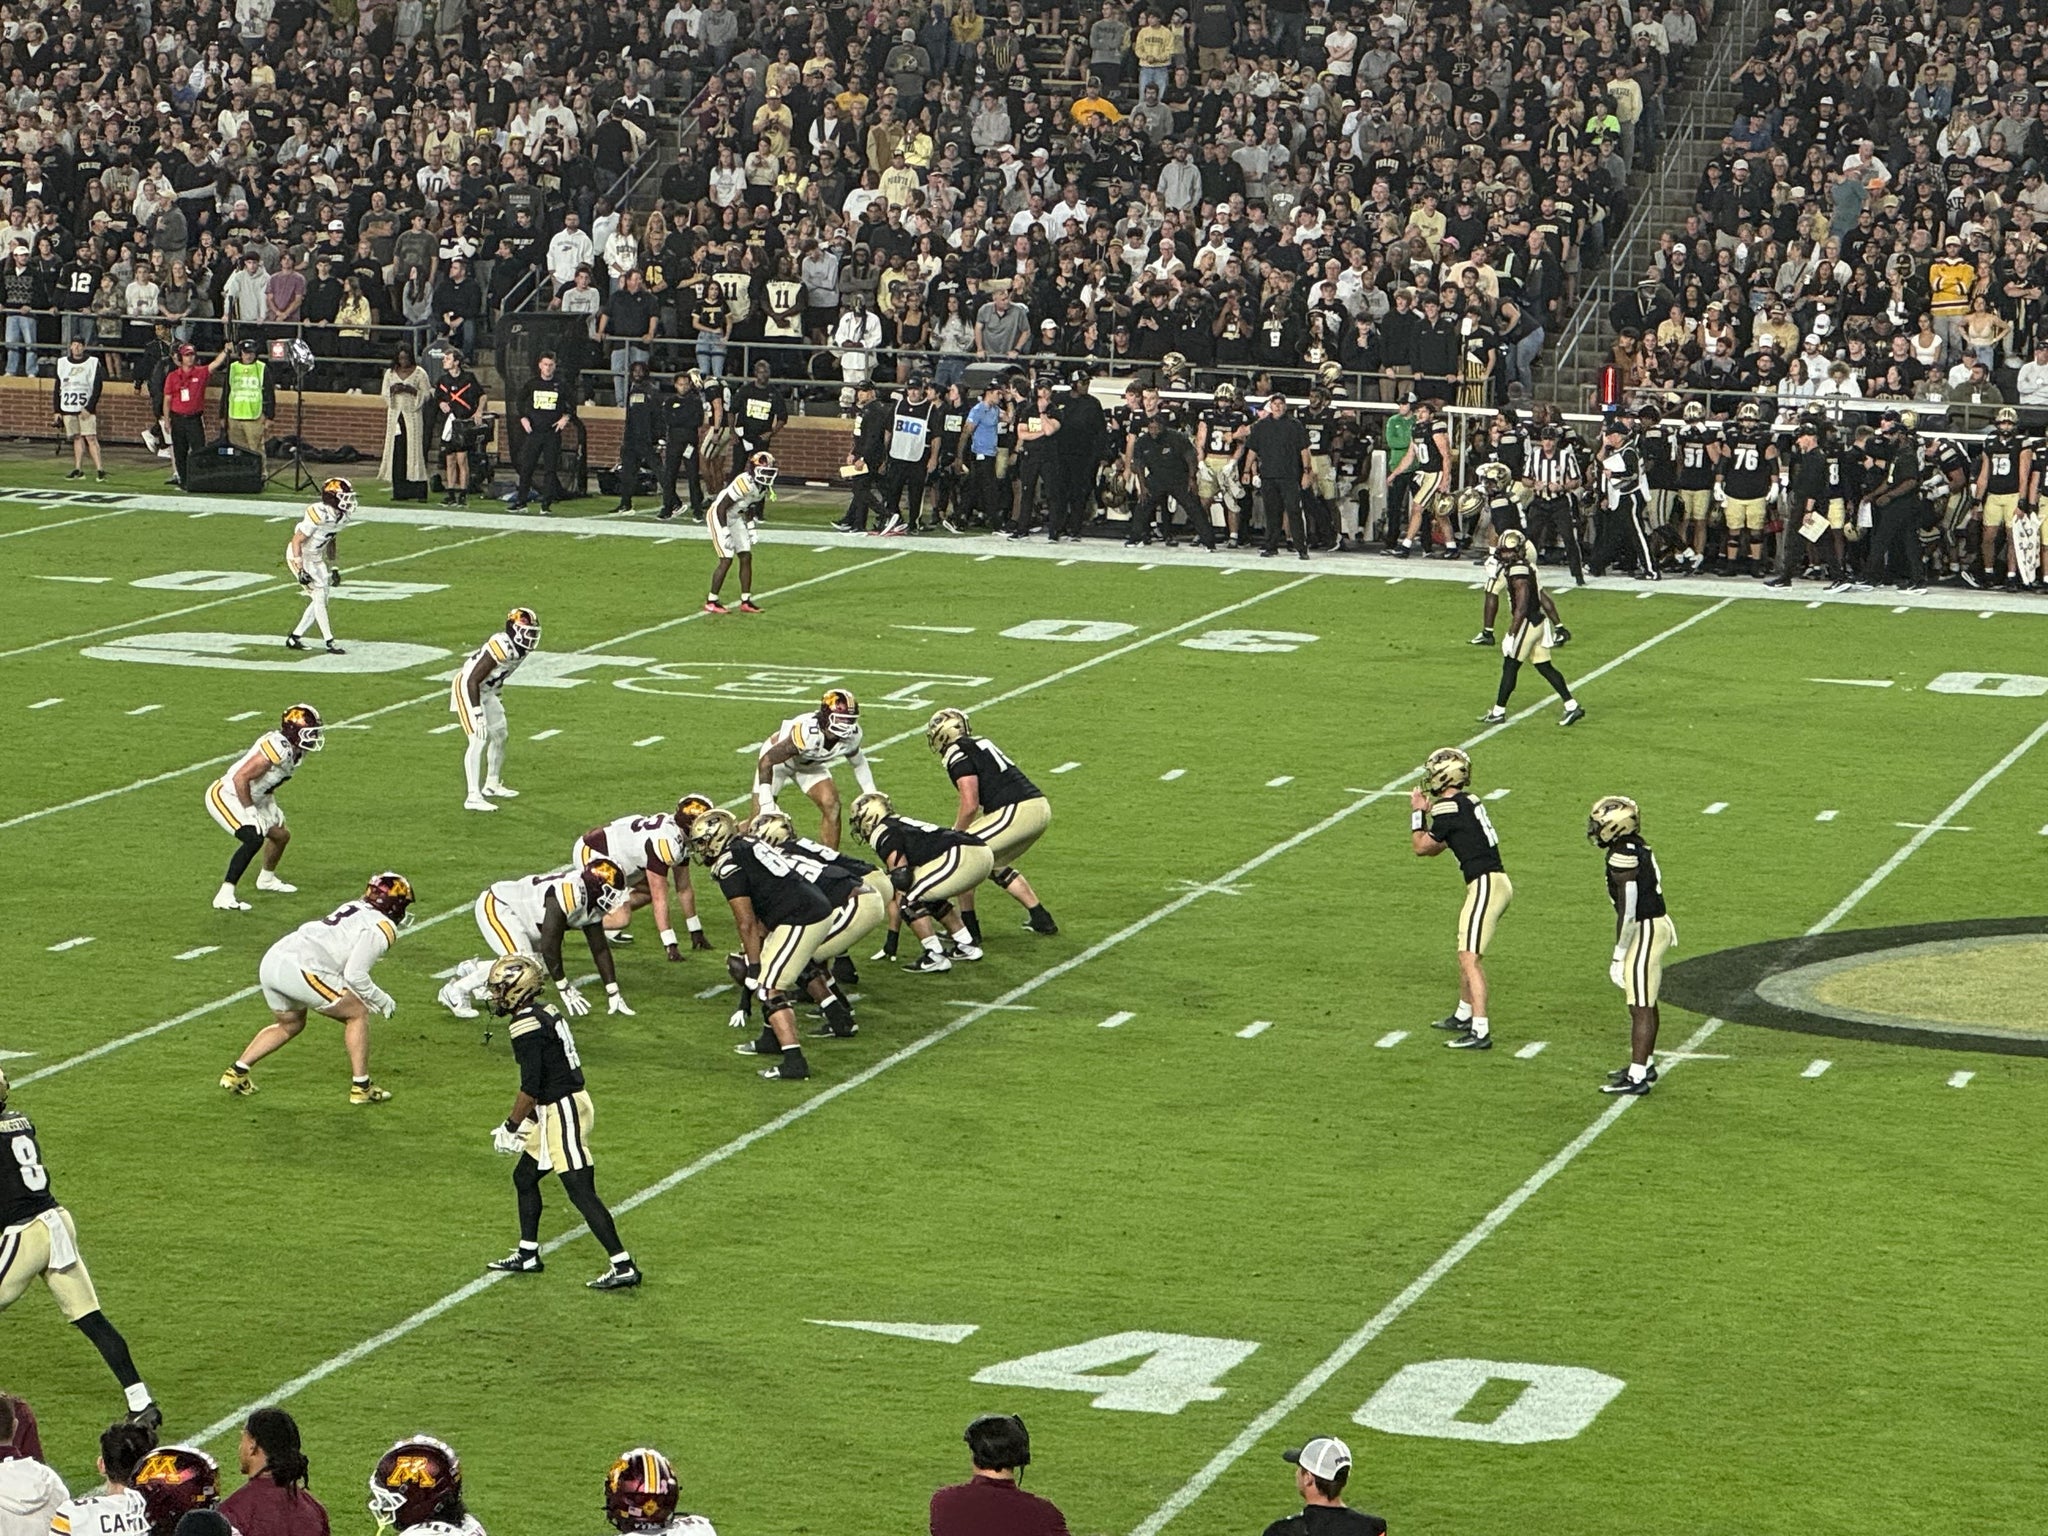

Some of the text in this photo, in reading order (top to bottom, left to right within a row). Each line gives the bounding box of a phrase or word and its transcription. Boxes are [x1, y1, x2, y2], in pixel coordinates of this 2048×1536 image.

[1557, 132, 1568, 153] 1
[71, 272, 92, 293] 12
[722, 282, 738, 301] 11
[775, 290, 791, 309] 11
[63, 392, 88, 406] 225
[1734, 449, 1759, 471] 76
[11, 1136, 48, 1192] 8
[136, 1455, 183, 1485] M
[387, 1457, 437, 1488] M
